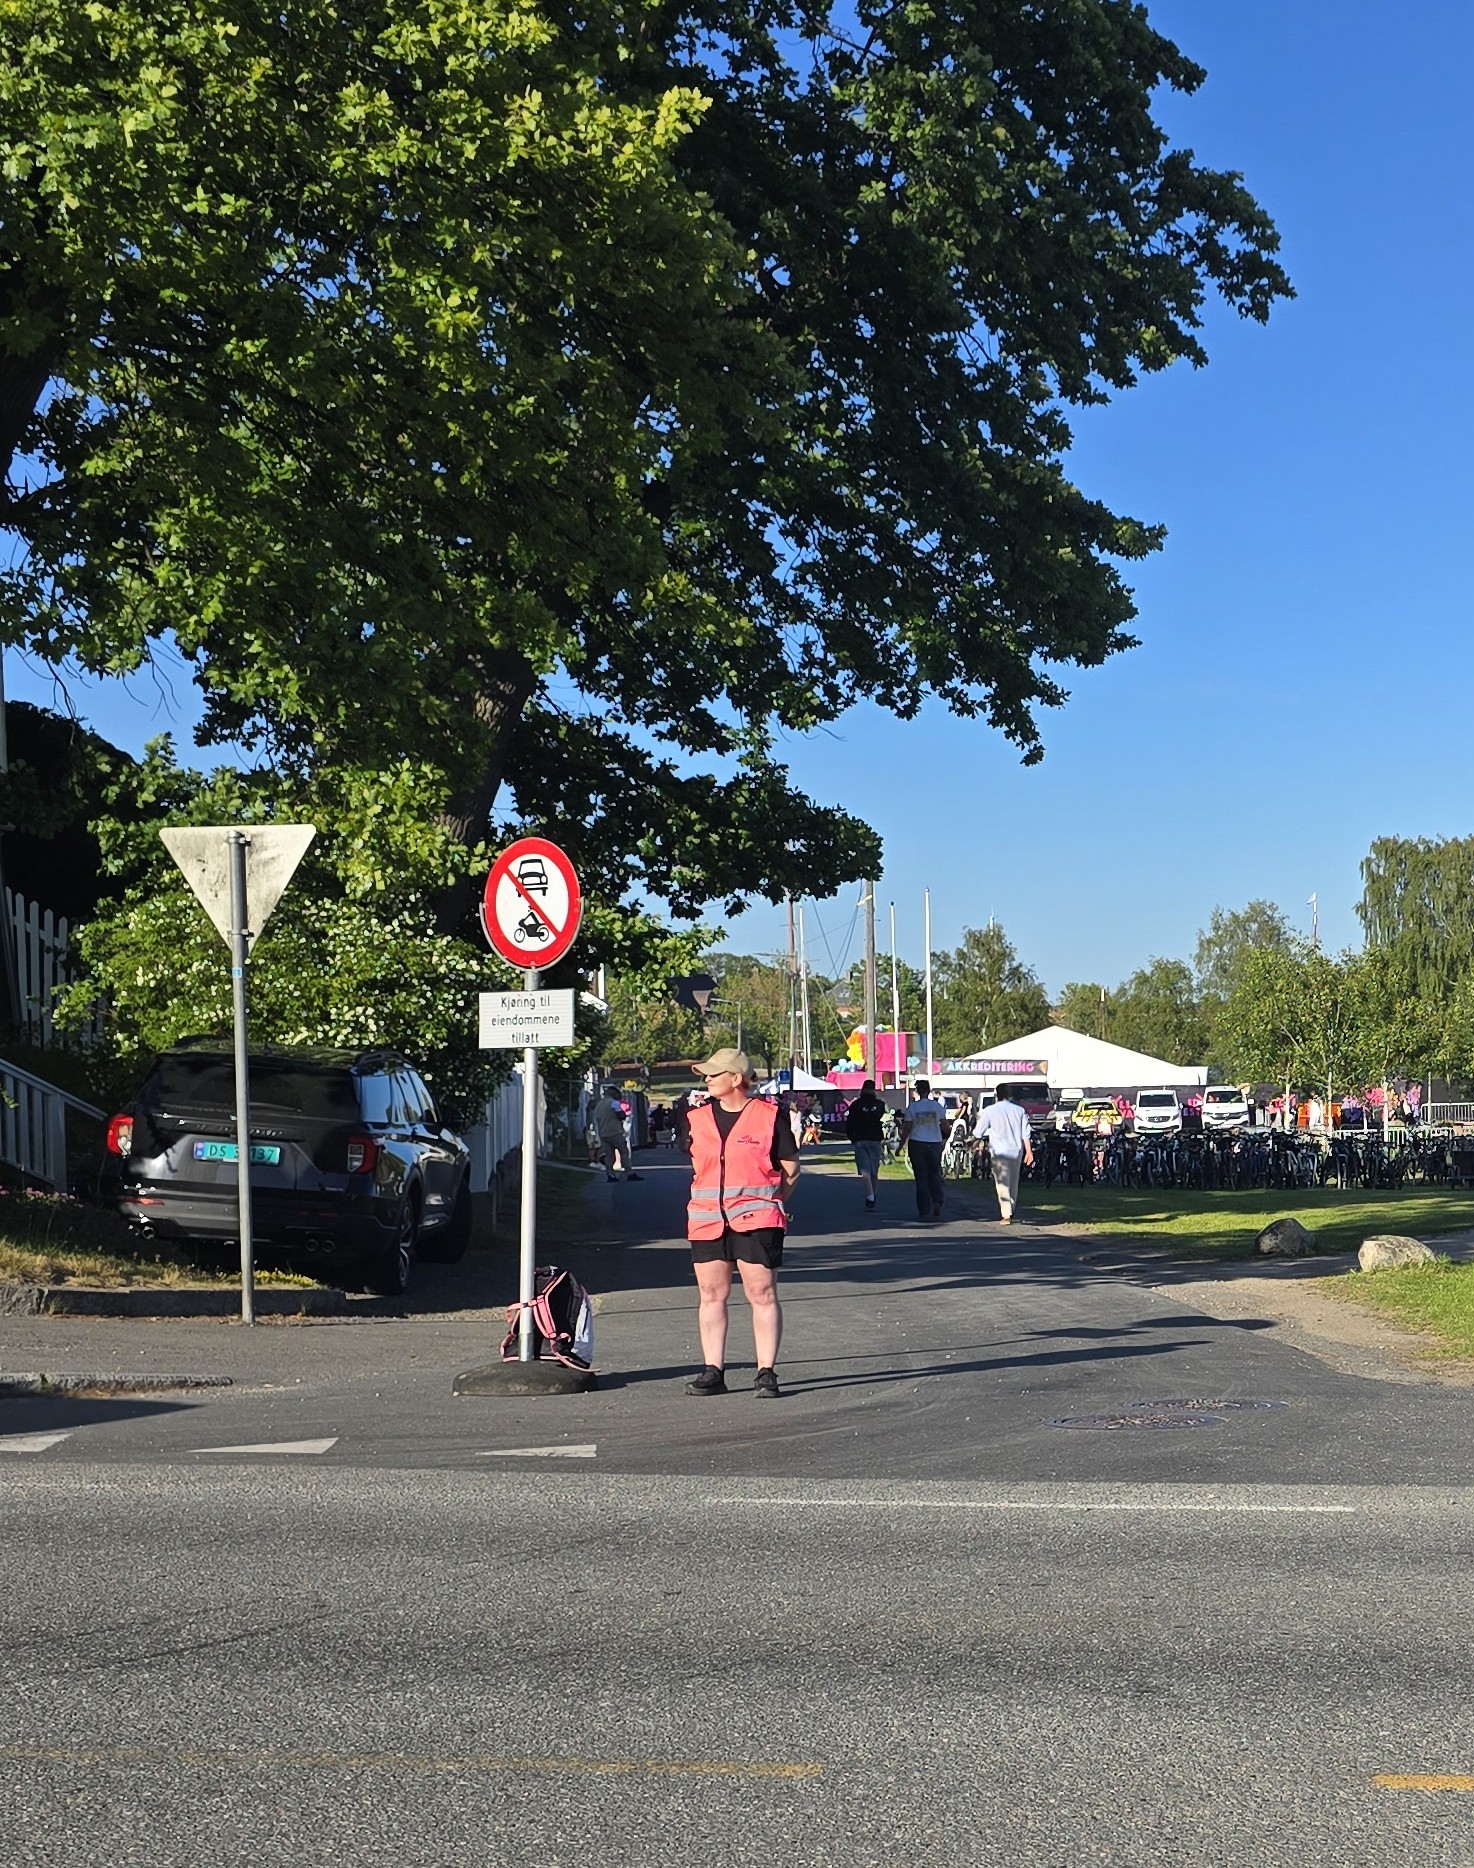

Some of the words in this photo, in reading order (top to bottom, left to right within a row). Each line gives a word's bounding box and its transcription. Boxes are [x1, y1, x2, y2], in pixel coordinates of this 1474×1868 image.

[501, 996, 536, 1010] Kjøring
[540, 995, 550, 1006] til
[491, 1014, 560, 1026] eiendommene
[511, 1032, 539, 1044] tillatt
[946, 1060, 1035, 1073] AKKREDITERING
[209, 1144, 227, 1157] DS
